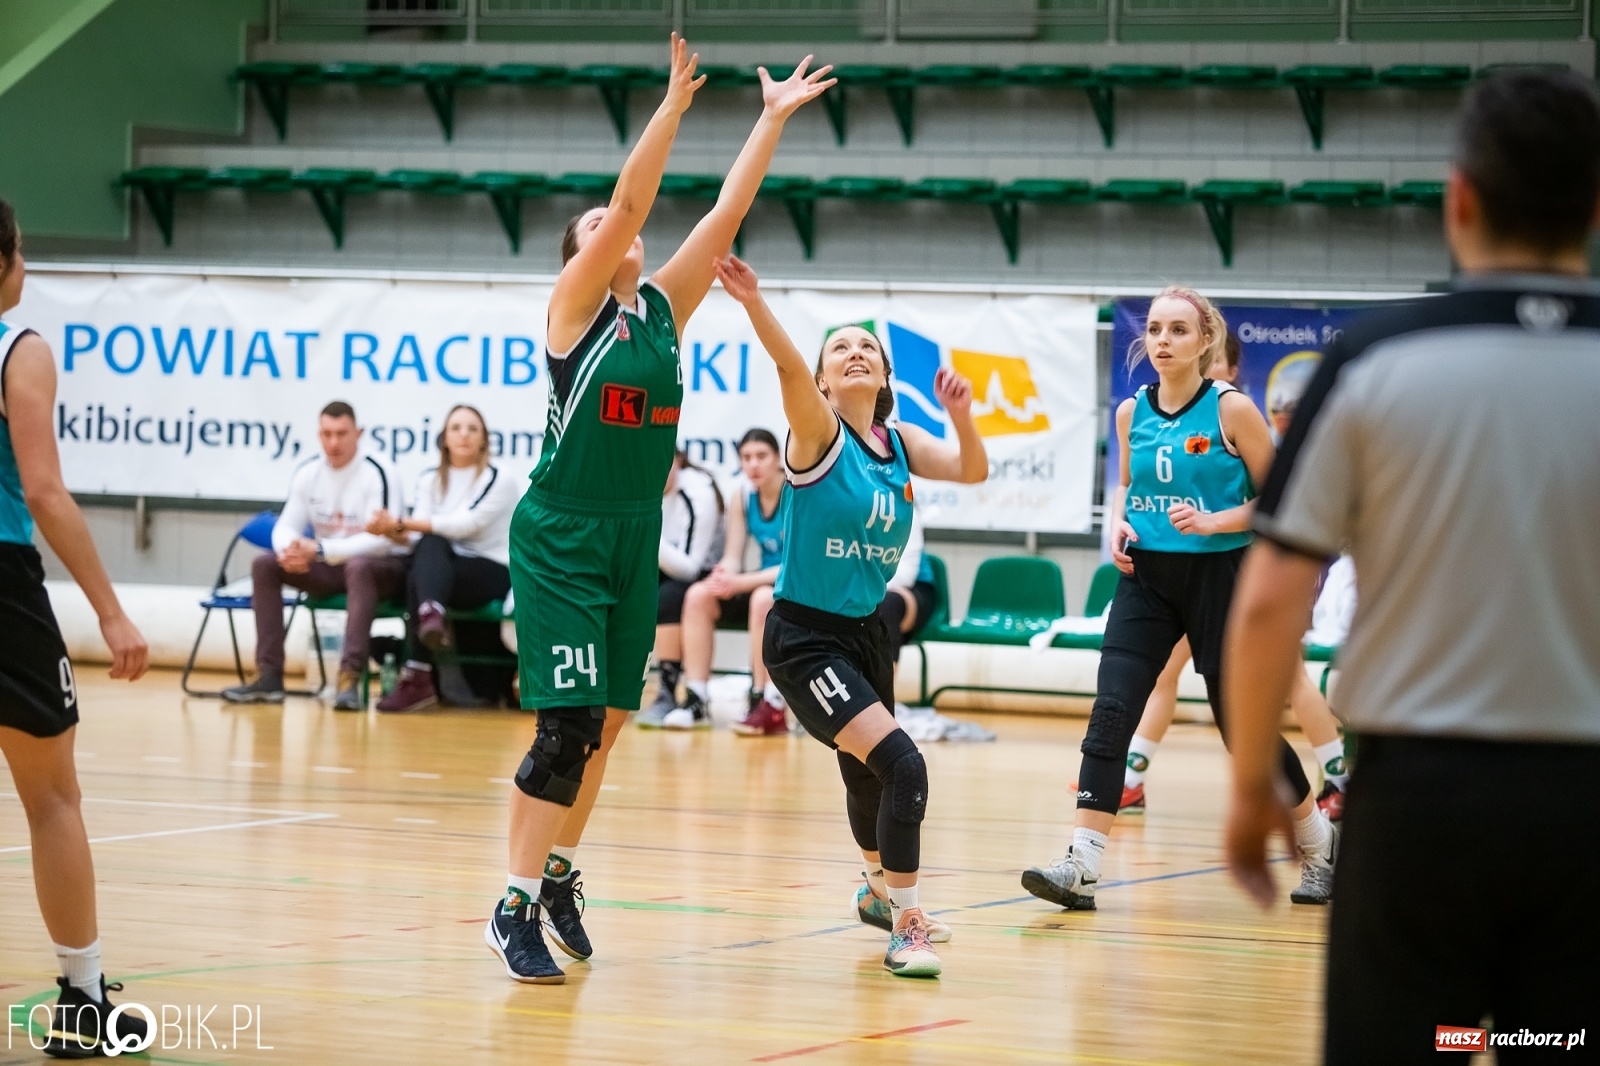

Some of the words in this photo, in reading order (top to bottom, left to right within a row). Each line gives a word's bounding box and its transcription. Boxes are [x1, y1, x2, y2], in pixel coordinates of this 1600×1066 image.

[63, 324, 320, 379] POWIAT
[343, 333, 750, 393] RACIBKI
[604, 389, 641, 422] K
[58, 403, 302, 459] kibicujemy,
[1155, 446, 1173, 483] 6
[865, 489, 896, 533] 14
[825, 537, 902, 565] BATPOL
[59, 656, 76, 709] 9
[552, 643, 598, 689] 24
[809, 666, 851, 717] 14
